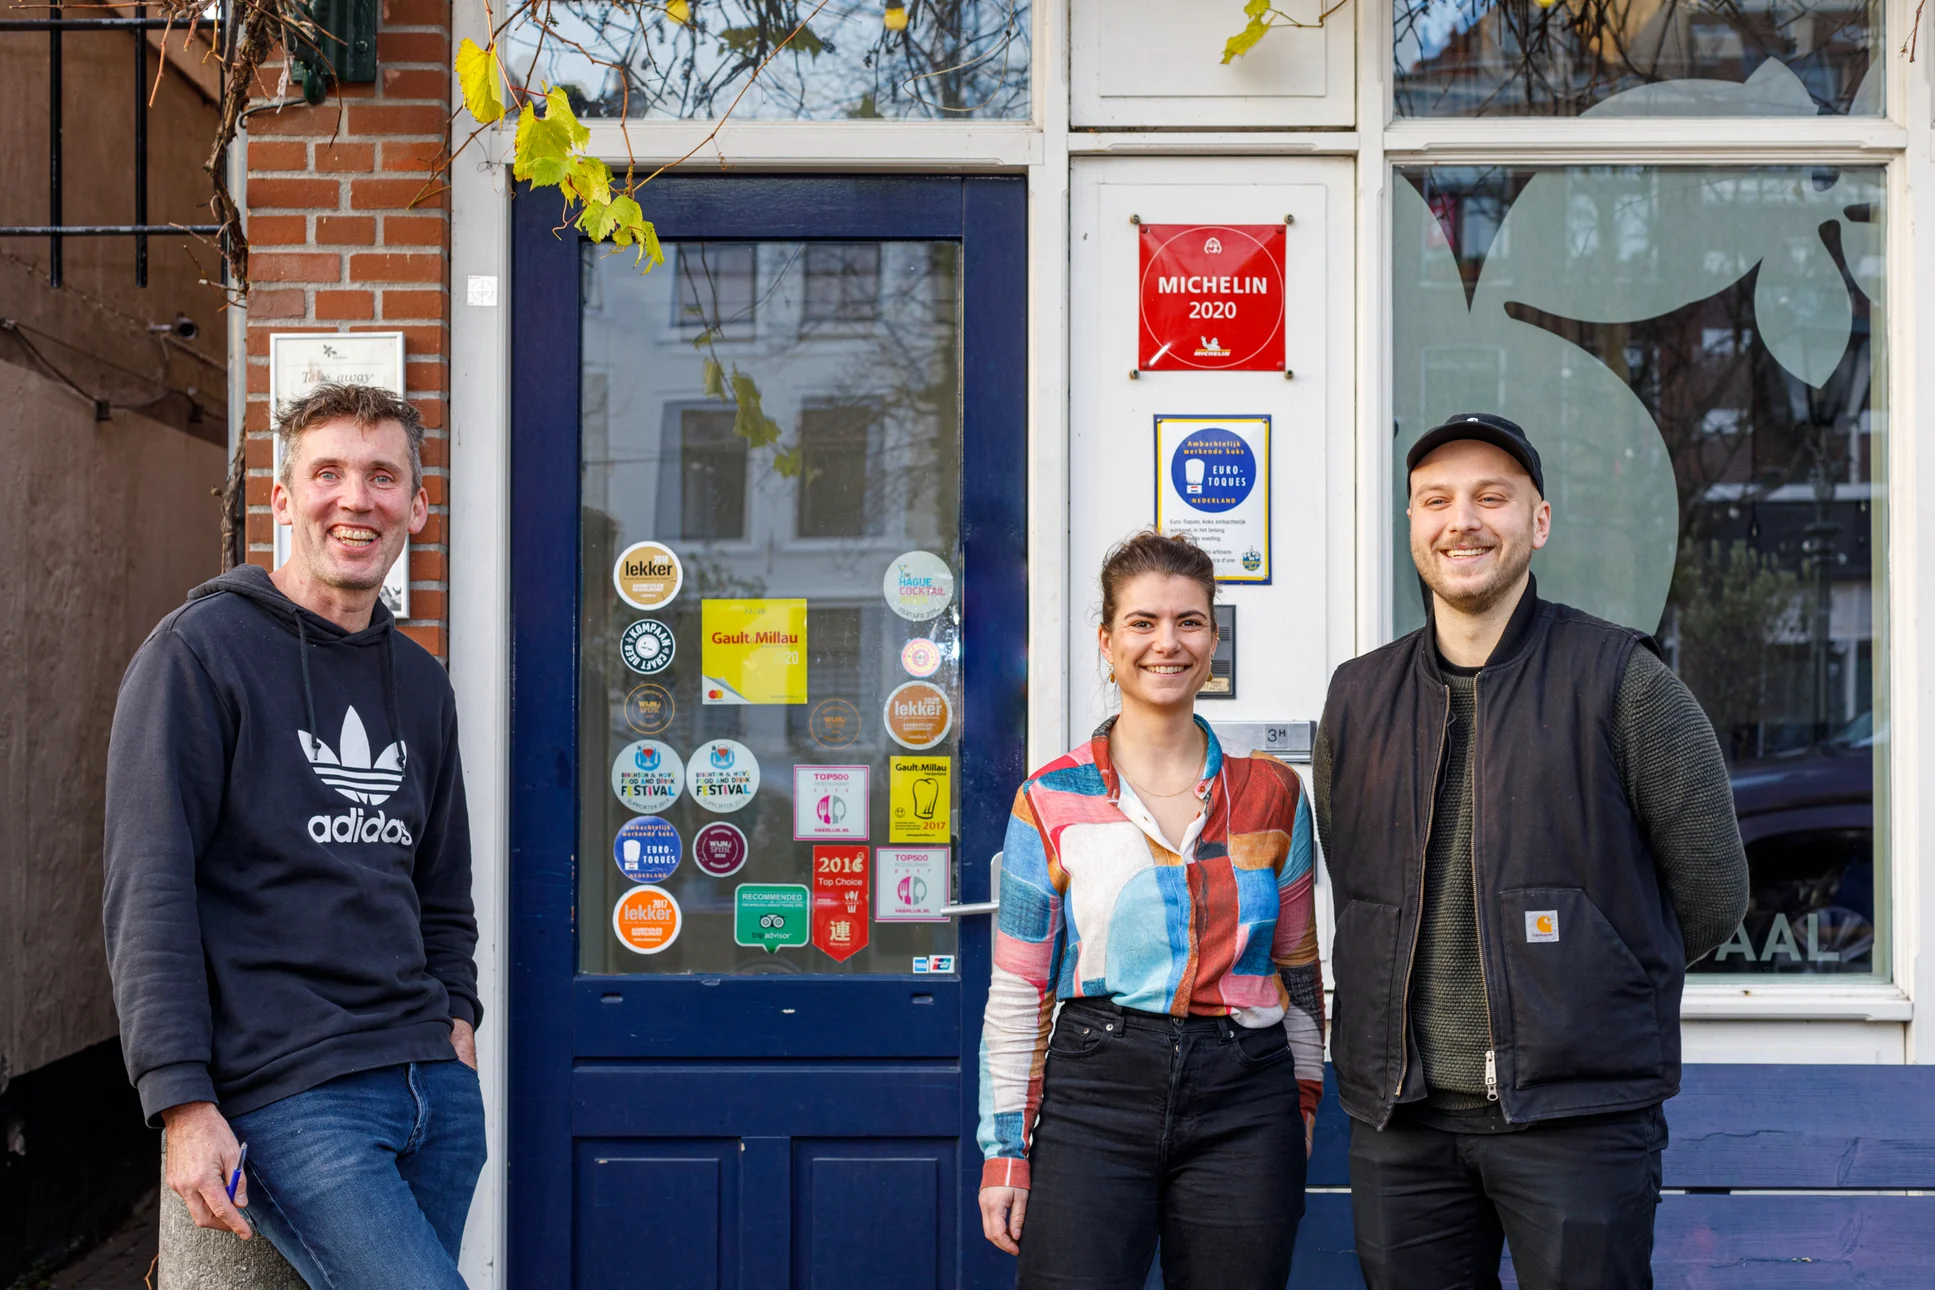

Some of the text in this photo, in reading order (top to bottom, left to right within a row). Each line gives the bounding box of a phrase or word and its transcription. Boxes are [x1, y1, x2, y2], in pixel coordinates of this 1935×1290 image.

[1158, 276, 1268, 295] MICHELIN
[1189, 301, 1237, 319] 2020
[336, 373, 374, 384] away
[1187, 440, 1241, 448] Ambachtelijk
[1212, 465, 1243, 475] EURO-
[1207, 477, 1247, 487] TOQUES
[625, 561, 673, 576] lekker
[899, 578, 932, 586] HAGUE
[899, 586, 946, 596] COCKTAIL
[629, 622, 671, 647] KOMPAAN
[624, 644, 668, 670] CRAFT BEER
[894, 700, 942, 716] lekker
[731, 776, 751, 784] DRINK
[813, 773, 850, 781] TOP500
[621, 785, 675, 797] FESTIVAL
[696, 784, 751, 796] FESTIVAL
[626, 798, 658, 811] SUPPORTER
[308, 807, 413, 846] adidas
[625, 824, 671, 832] Ambachtelijk
[923, 821, 946, 830] 2017
[647, 845, 674, 854] EURO-
[643, 855, 676, 864] TOQUES
[894, 854, 929, 862] TOP500
[818, 856, 864, 873] 2016
[818, 877, 863, 886] Top Choice
[742, 893, 803, 901] RECOMMENDED
[652, 899, 668, 909] 2017
[624, 904, 672, 921] lekker
[752, 932, 791, 940] tripadvisor
[829, 920, 851, 942] 連
[1714, 912, 1840, 962] AAL
